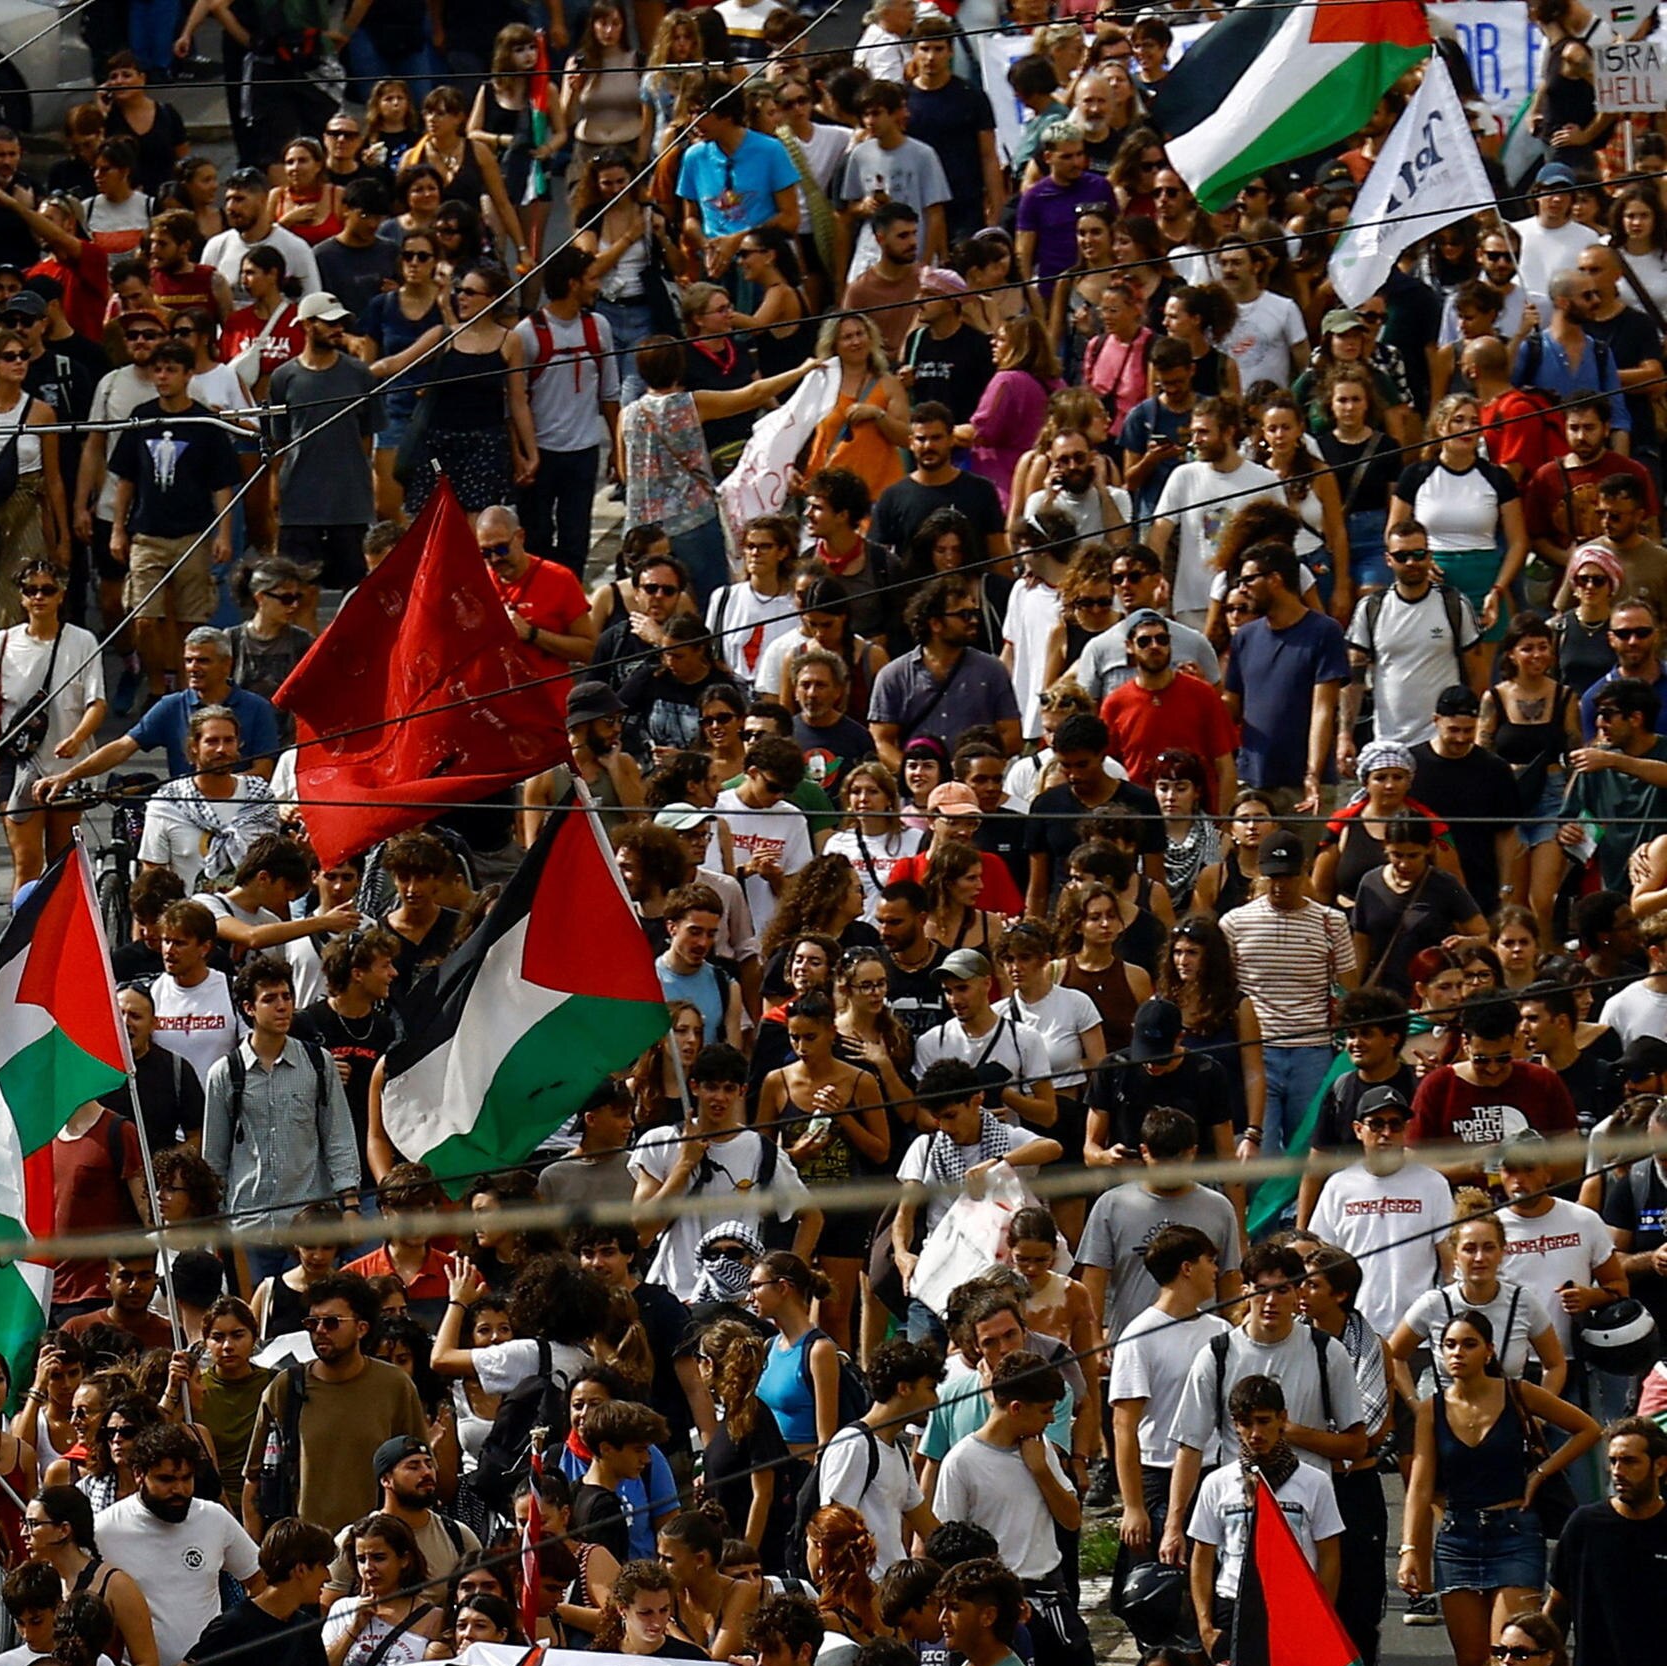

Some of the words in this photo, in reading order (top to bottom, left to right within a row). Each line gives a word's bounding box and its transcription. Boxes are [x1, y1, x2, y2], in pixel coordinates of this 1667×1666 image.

[1599, 45, 1660, 73] ISRA
[1598, 76, 1659, 105] HELL
[1471, 1106, 1502, 1119] THE
[1452, 1117, 1503, 1133] NORTH
[1460, 1131, 1503, 1144] WEST
[1345, 1202, 1379, 1217] ROMA
[1388, 1200, 1422, 1214] GAZA
[1547, 1233, 1581, 1249] GAZA
